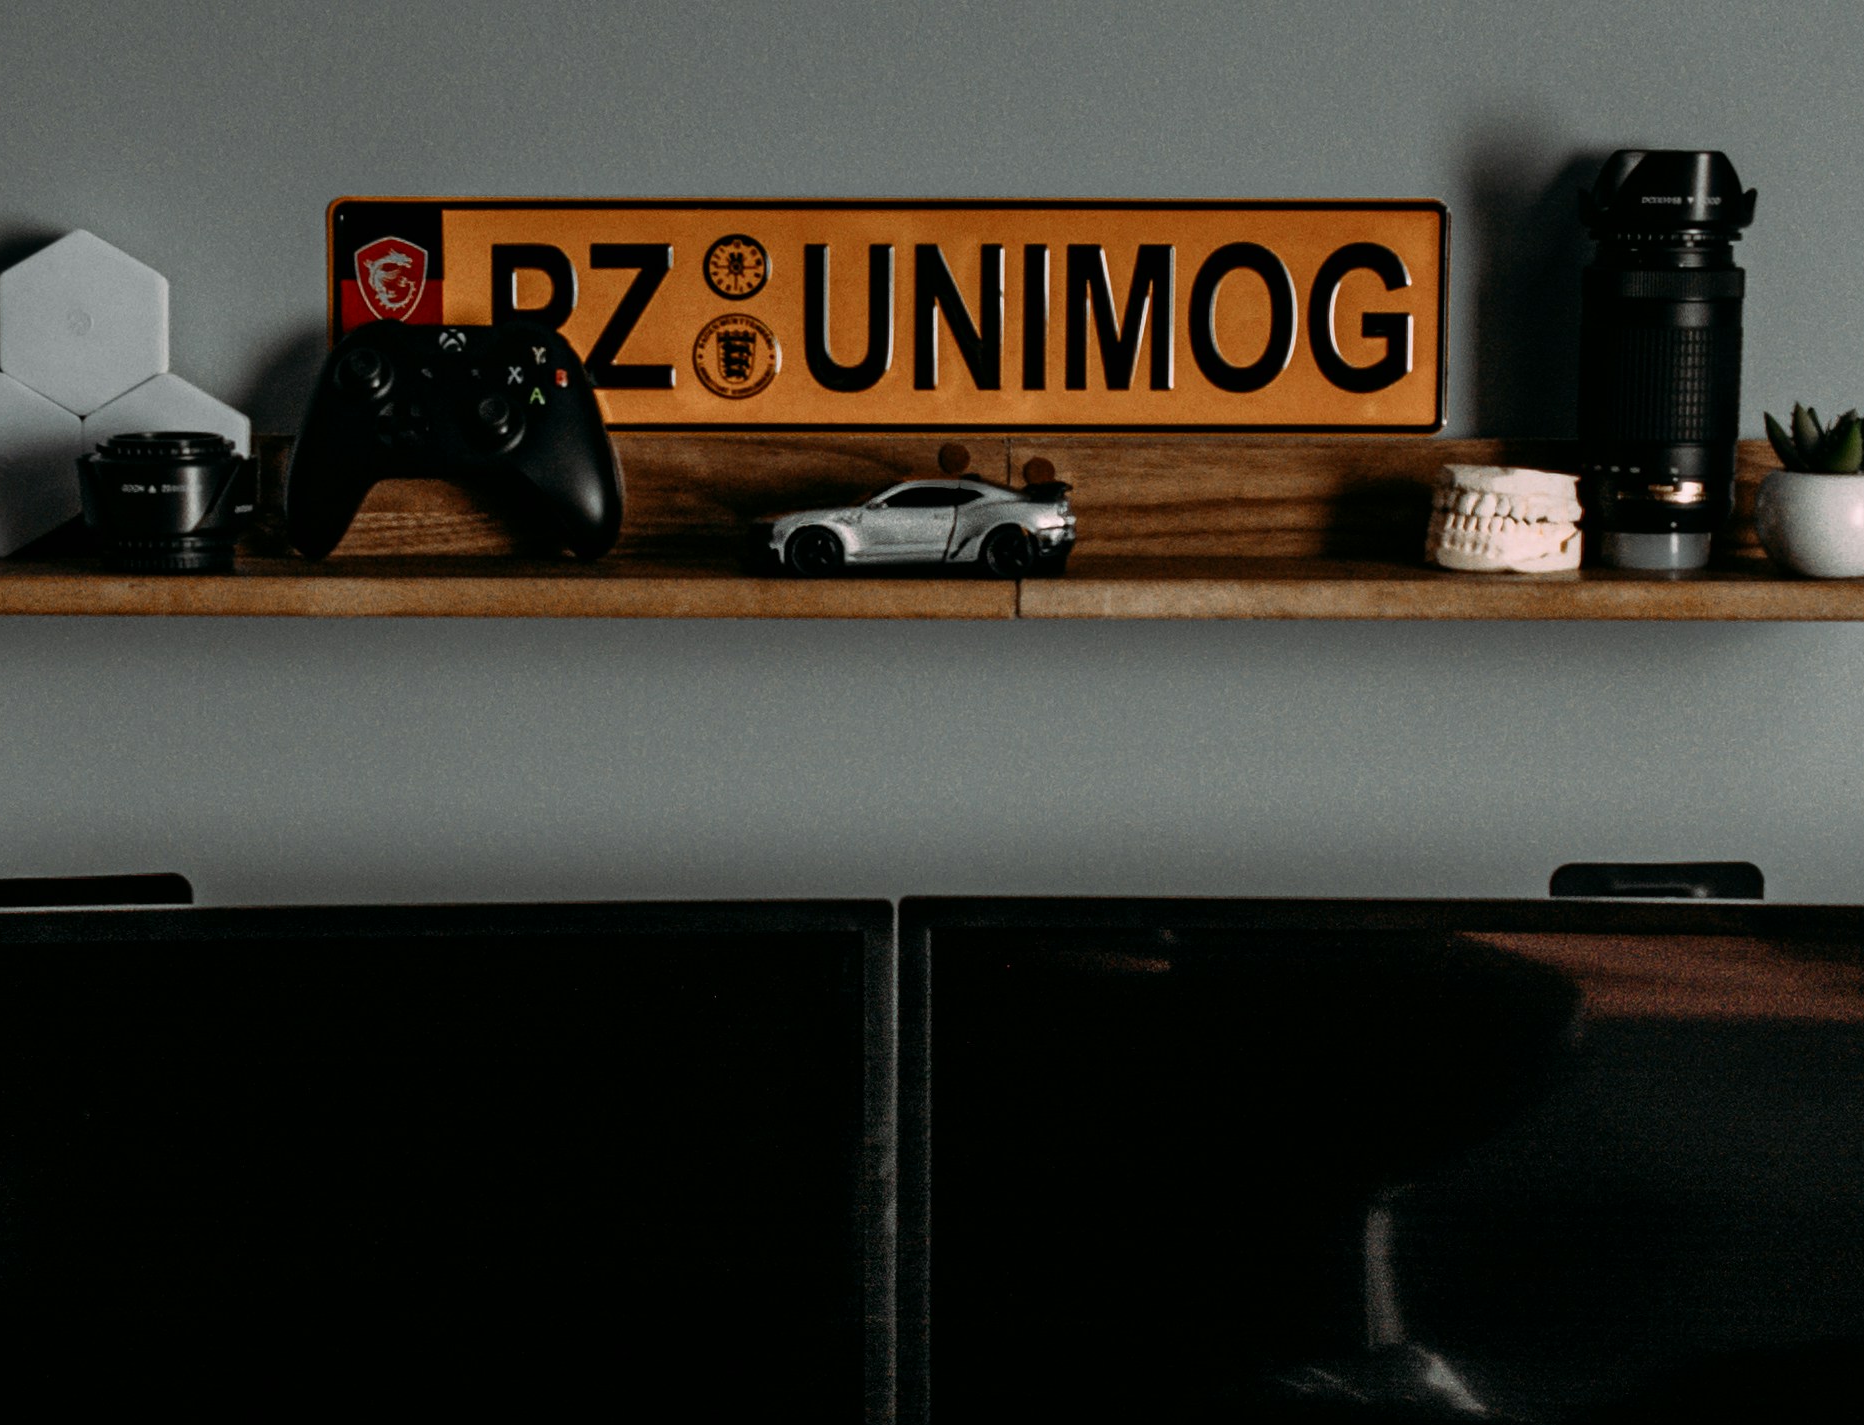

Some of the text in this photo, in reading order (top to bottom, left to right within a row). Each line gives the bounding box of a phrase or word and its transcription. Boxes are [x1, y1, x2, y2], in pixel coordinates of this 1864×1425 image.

[802, 241, 1416, 394] UNIMOG
[532, 346, 547, 365] Y
[507, 366, 523, 385] X
[529, 387, 546, 405] A
